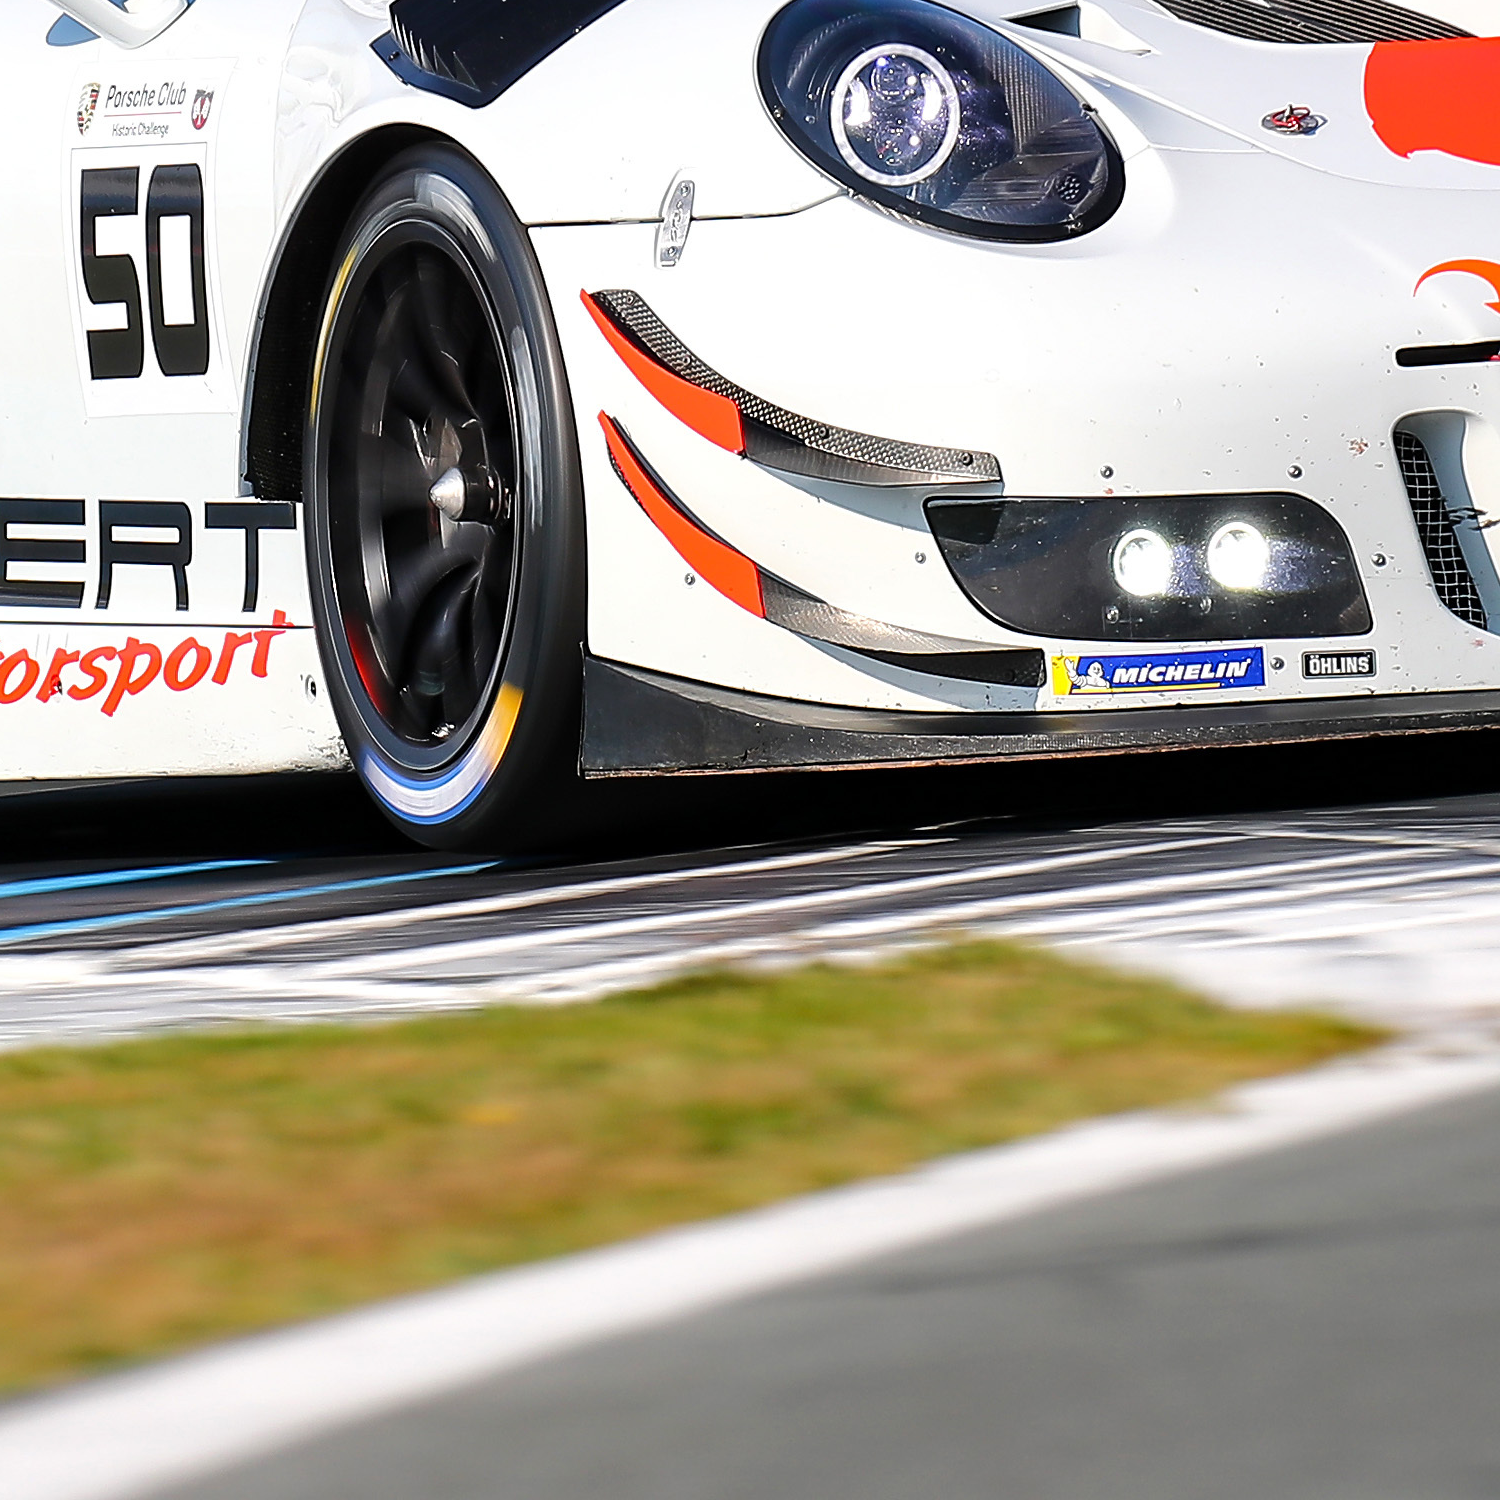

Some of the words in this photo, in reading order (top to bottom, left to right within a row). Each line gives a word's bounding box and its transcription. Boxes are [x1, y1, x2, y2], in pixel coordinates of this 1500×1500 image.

[105, 83, 156, 109] Porsche
[157, 81, 187, 107] Club
[111, 123, 137, 138] Historic
[137, 121, 170, 139] Challenge
[80, 162, 210, 380] 50
[1111, 659, 1250, 685] MICHELIN
[1308, 654, 1371, 676] ÖHLINS
